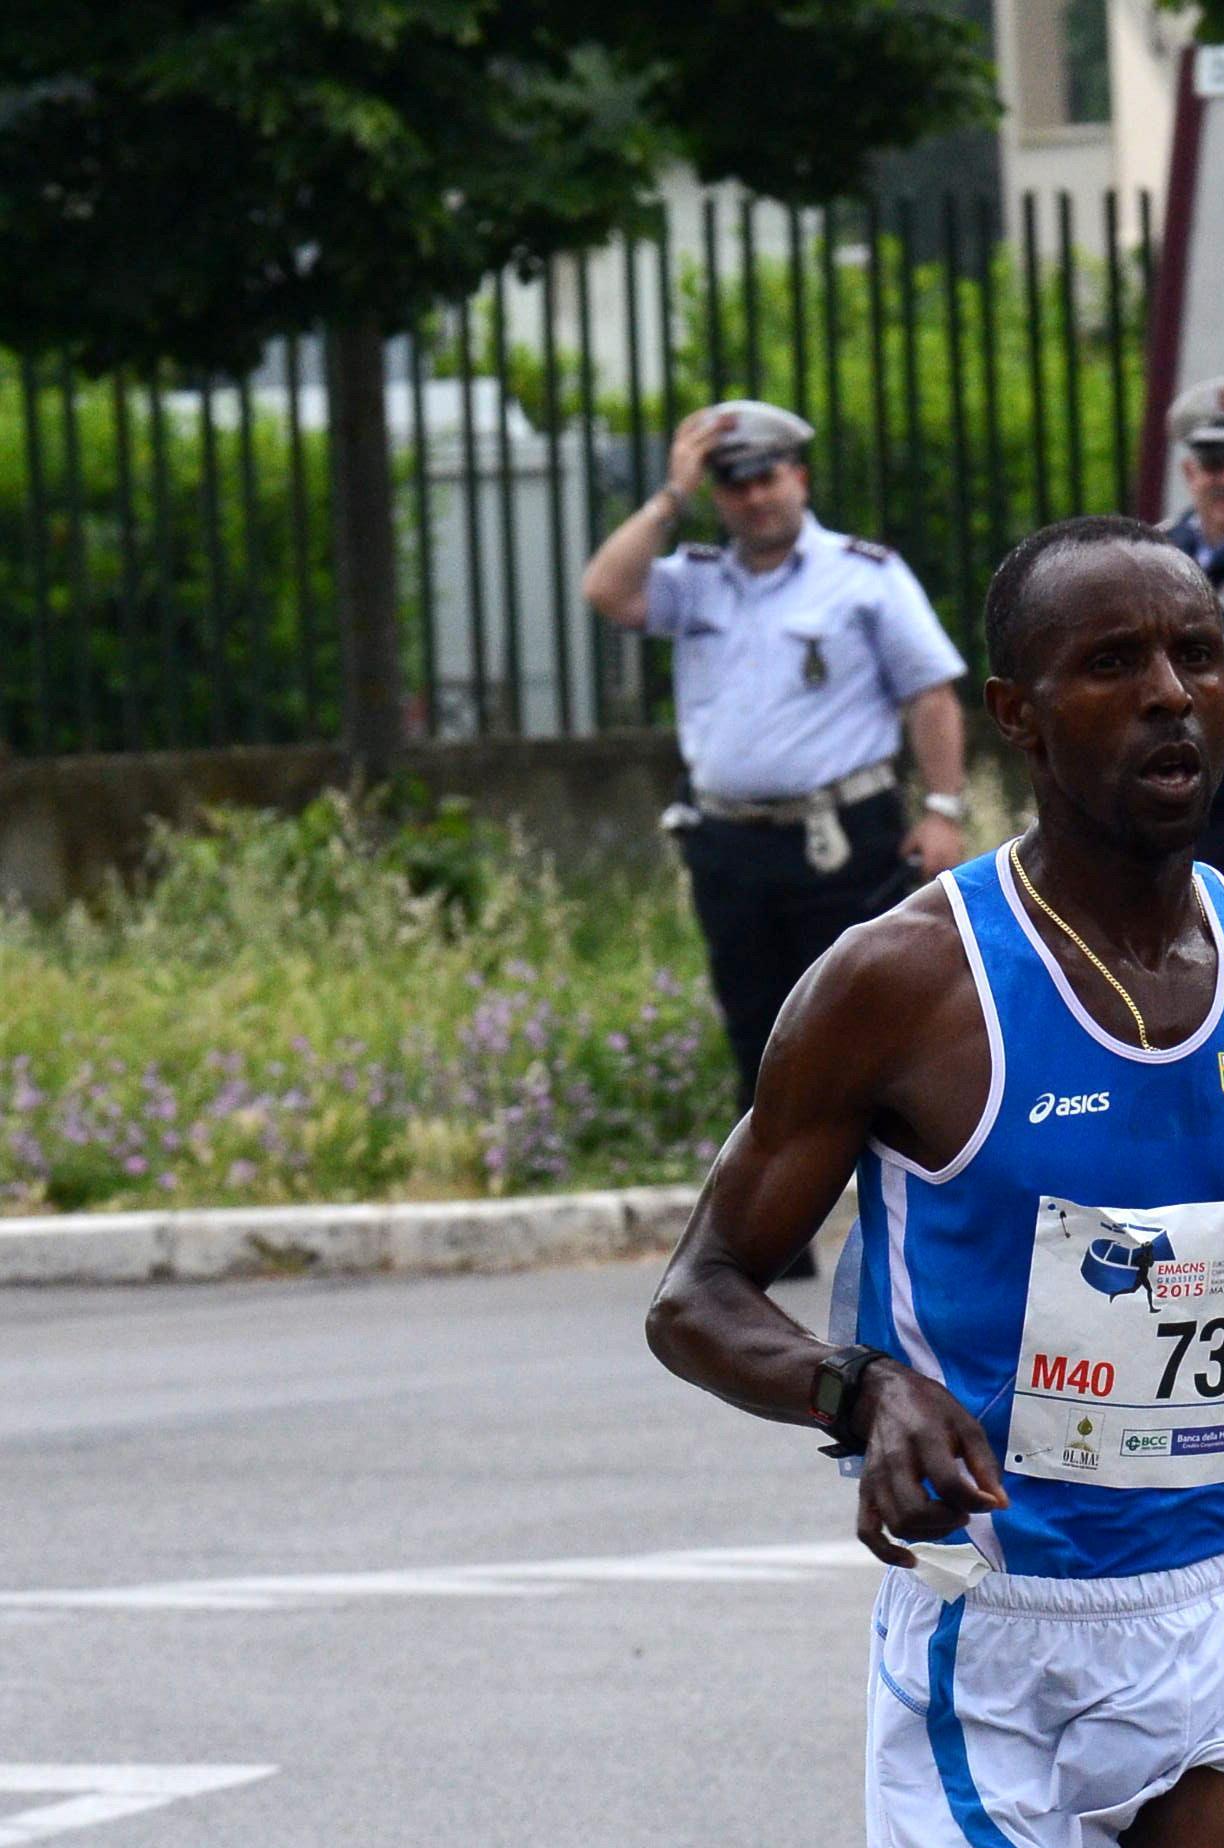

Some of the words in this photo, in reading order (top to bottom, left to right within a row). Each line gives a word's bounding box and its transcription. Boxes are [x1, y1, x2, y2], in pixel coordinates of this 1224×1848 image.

[1056, 1092, 1110, 1116] asics
[1157, 1262, 1205, 1275] EMACNS
[1156, 1275, 1205, 1284] GROSSETO
[1156, 1283, 1204, 1299] 2015
[1031, 1353, 1115, 1397] M40
[1141, 1435, 1168, 1446] BCC
[1177, 1434, 1200, 1443] Banca
[1202, 1431, 1218, 1442] della
